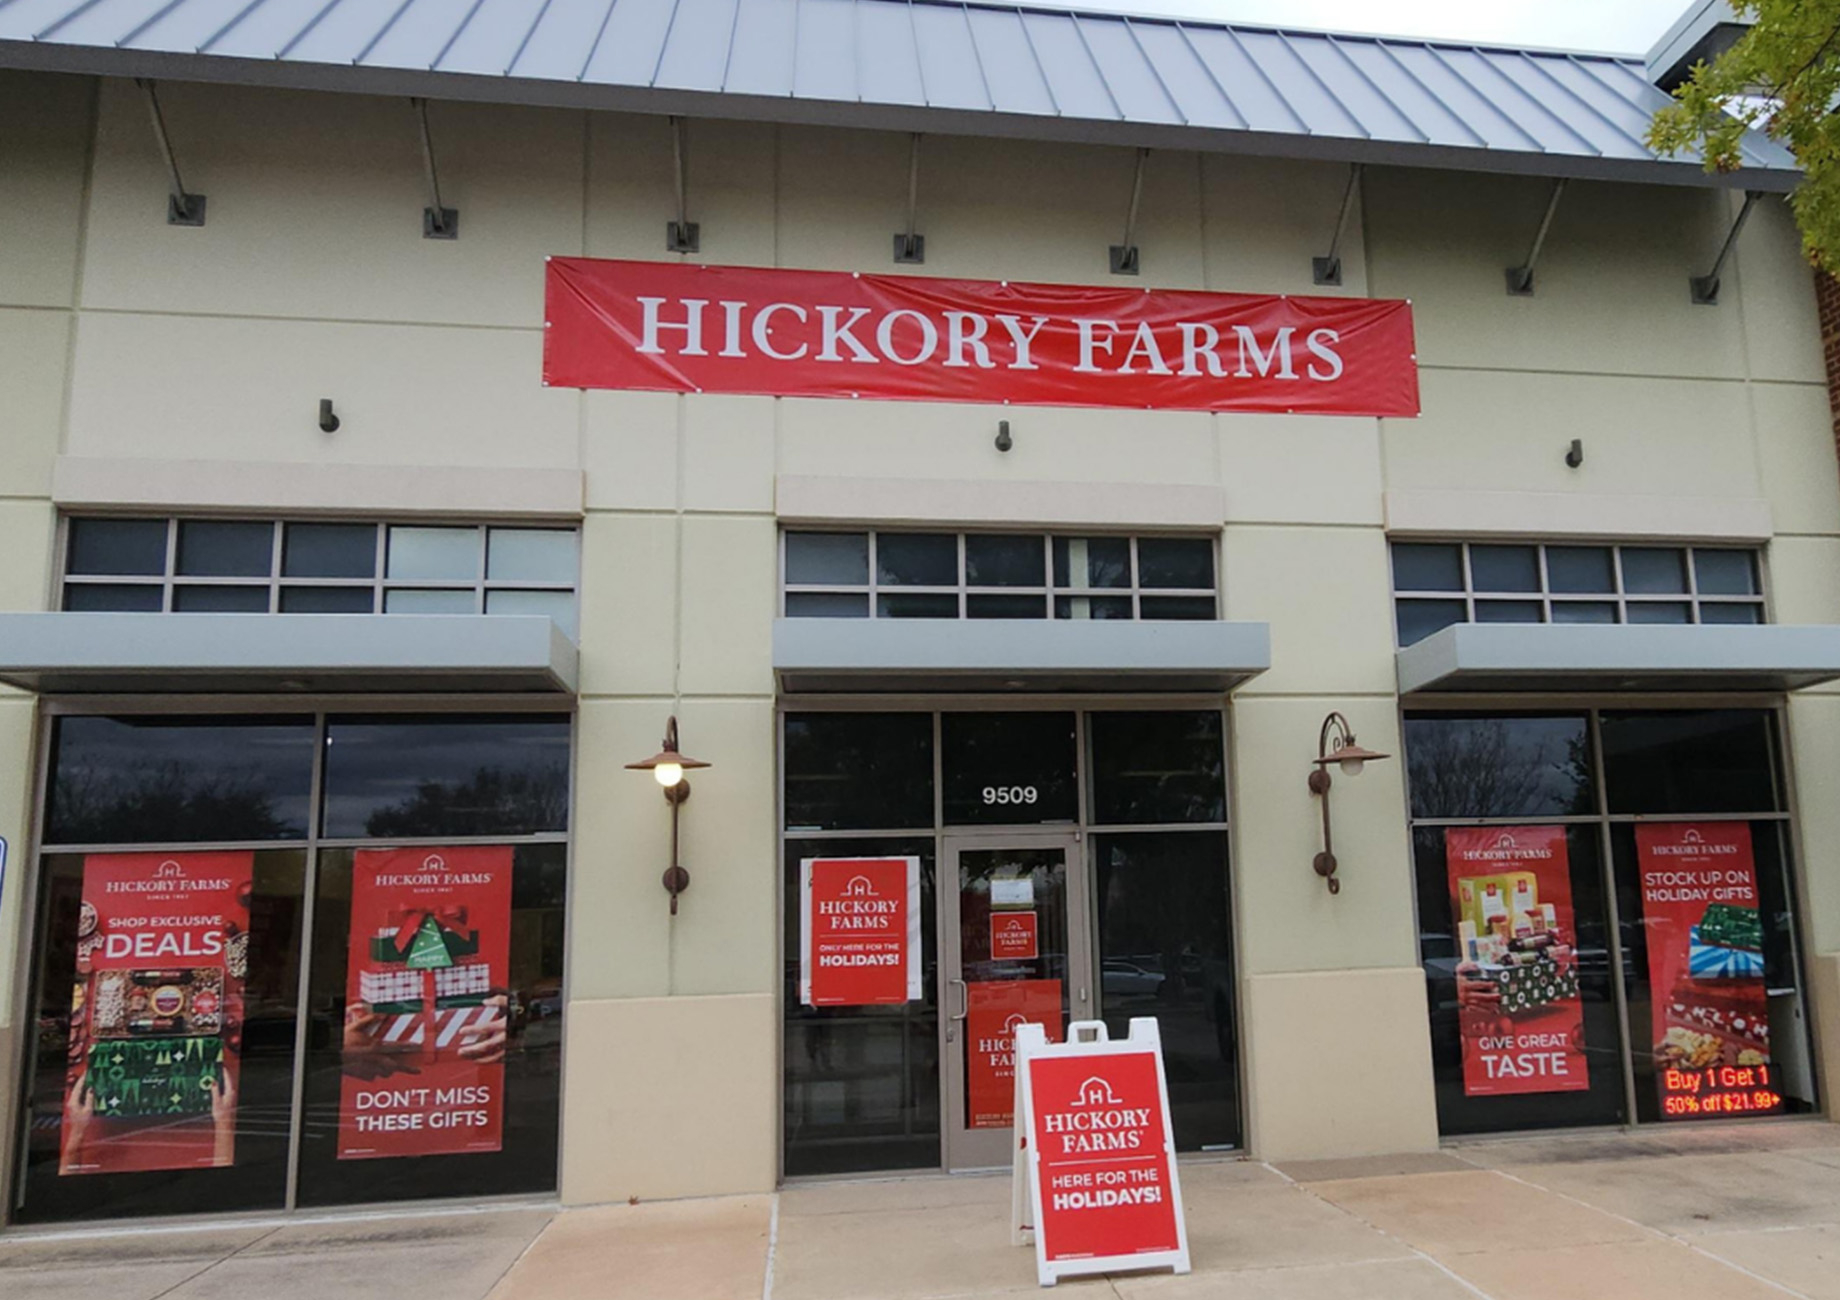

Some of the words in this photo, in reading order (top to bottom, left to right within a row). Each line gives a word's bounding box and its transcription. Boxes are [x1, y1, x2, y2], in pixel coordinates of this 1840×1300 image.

[635, 296, 1049, 370] HICKORY
[1072, 318, 1344, 381] FARMS
[982, 786, 1038, 805] 9509
[1463, 849, 1512, 860] HICKORY
[1652, 845, 1699, 855] HICKORY
[106, 880, 177, 893] HICKORY
[179, 878, 231, 891] FARMS
[375, 874, 440, 886] HICKORY
[443, 873, 492, 885] FARMS
[1645, 872, 1697, 886] STOCK
[1700, 871, 1722, 885] UP
[1725, 870, 1750, 884] ON
[1646, 888, 1710, 902] HOLIDAY
[1713, 886, 1753, 900] GIFTS
[820, 900, 898, 914] HICKORY
[108, 917, 147, 928] SHOP
[151, 915, 222, 927] EXCLUSIVE
[831, 915, 889, 929] FARMS
[105, 930, 222, 958] DEALS
[819, 944, 841, 952] ONLY
[866, 943, 882, 951] FOR
[820, 954, 899, 966] HOLIDAYS!
[1478, 1036, 1514, 1050] GIVE
[1517, 1033, 1567, 1048] GREAT
[1480, 1052, 1568, 1078] TASTE
[1666, 1069, 1701, 1093] Buy
[1706, 1068, 1716, 1087] 1
[1721, 1067, 1755, 1086] Get
[1758, 1065, 1768, 1085] 1
[356, 1088, 430, 1110] DON'T
[436, 1086, 490, 1106] MISS
[1665, 1096, 1700, 1114] 50%
[1702, 1094, 1721, 1111] off
[355, 1113, 424, 1132] THESE
[429, 1110, 488, 1129] GIFTS
[1044, 1108, 1151, 1133] HICKORY
[1062, 1131, 1140, 1153] FARMS
[1052, 1173, 1093, 1188] HERE
[1096, 1171, 1126, 1185] FOR
[1128, 1168, 1158, 1182] THE
[1053, 1186, 1162, 1211] HOLIDAYS!
